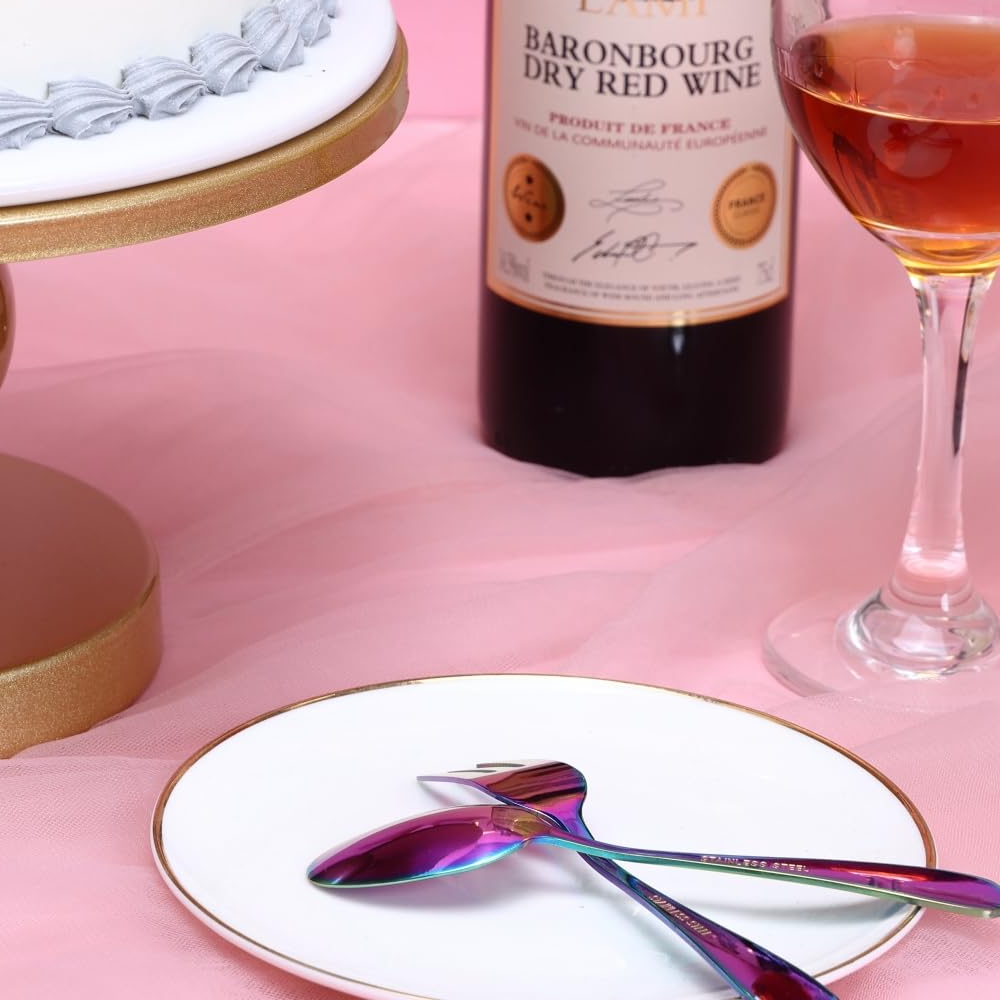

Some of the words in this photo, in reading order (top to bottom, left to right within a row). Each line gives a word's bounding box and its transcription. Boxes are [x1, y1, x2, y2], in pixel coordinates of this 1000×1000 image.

[524, 24, 754, 70] BARONBOURG
[523, 53, 585, 92] DRY
[597, 72, 668, 99] RED
[681, 62, 761, 97] WINE
[548, 111, 624, 134] PRODUIT
[630, 122, 656, 135] DE
[661, 117, 731, 135] FRANCE
[551, 130, 568, 142] LA
